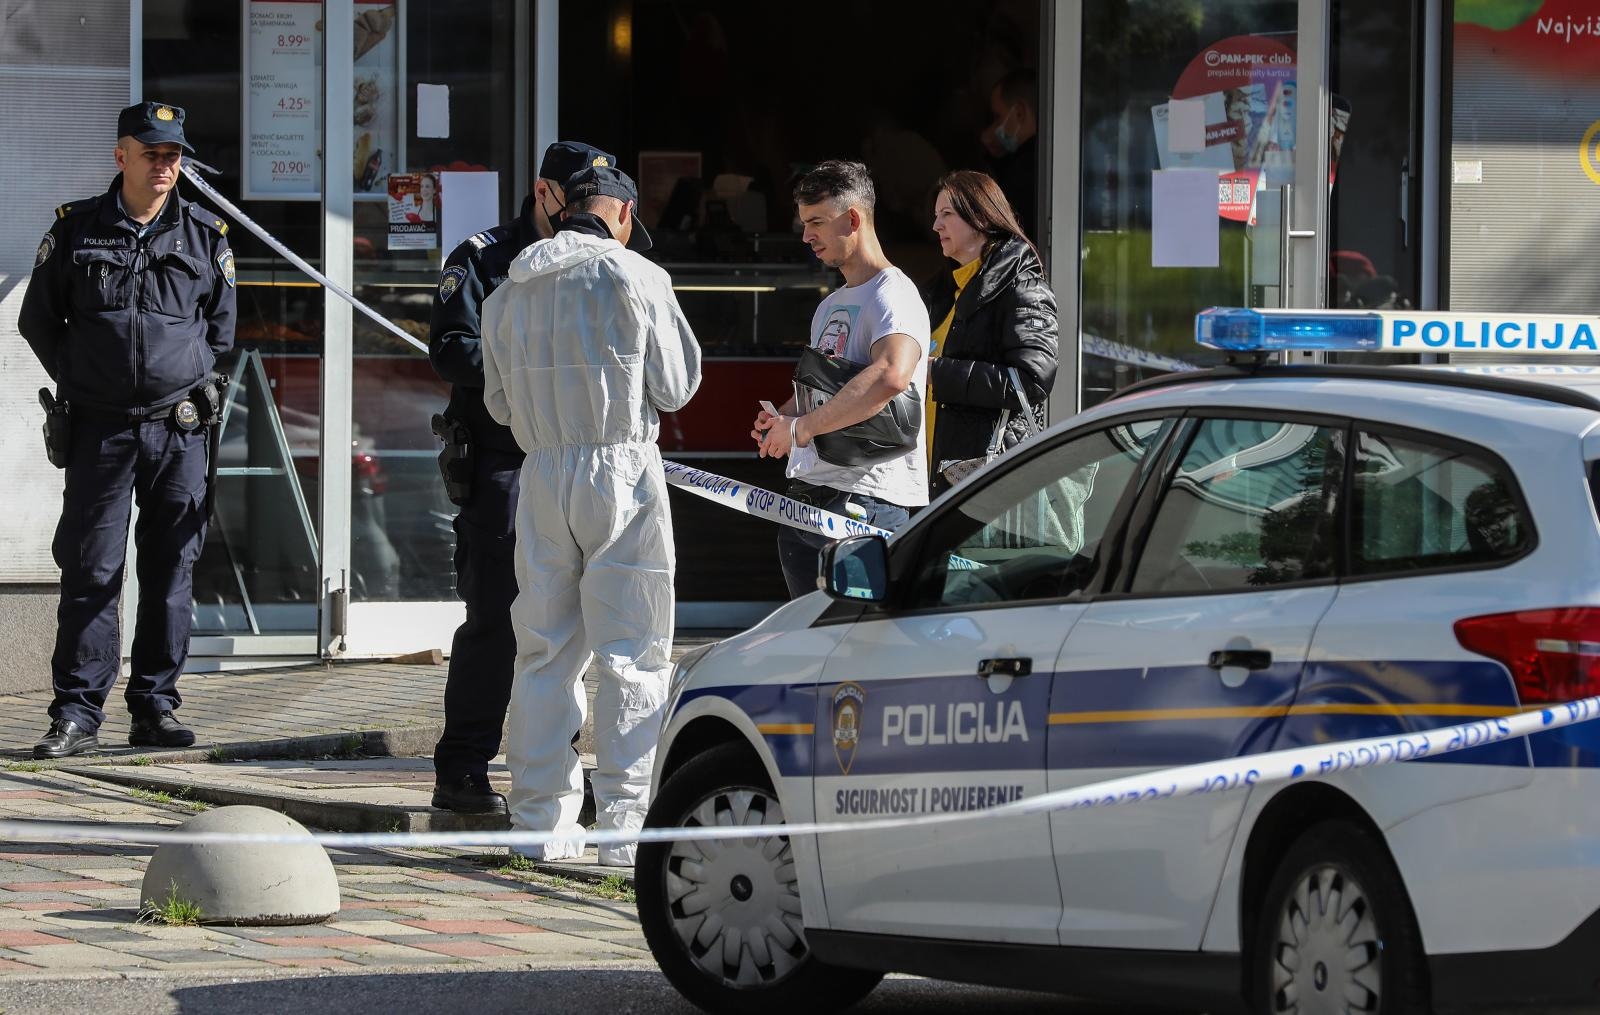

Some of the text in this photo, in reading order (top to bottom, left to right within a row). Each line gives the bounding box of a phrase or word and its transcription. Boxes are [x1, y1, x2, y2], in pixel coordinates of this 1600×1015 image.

[277, 34, 304, 47] 8.99
[1220, 52, 1292, 64] PAN-PEK club
[1207, 68, 1234, 77] prepaid
[1242, 68, 1266, 77] loyalty
[1267, 68, 1291, 77] kartica
[277, 97, 303, 110] 4.25
[1206, 127, 1237, 140] AN-PEK
[271, 161, 304, 174] 20.90
[390, 223, 426, 233] PRODAVAČ
[84, 237, 116, 246] POLICIJA
[1392, 320, 1597, 350] POLICIJA
[682, 469, 732, 495] POLICIJA
[747, 488, 824, 529] STOP POLICIJA
[881, 700, 1030, 747] POLICIJA
[835, 787, 918, 815] SIGURNOST
[921, 787, 927, 813] I
